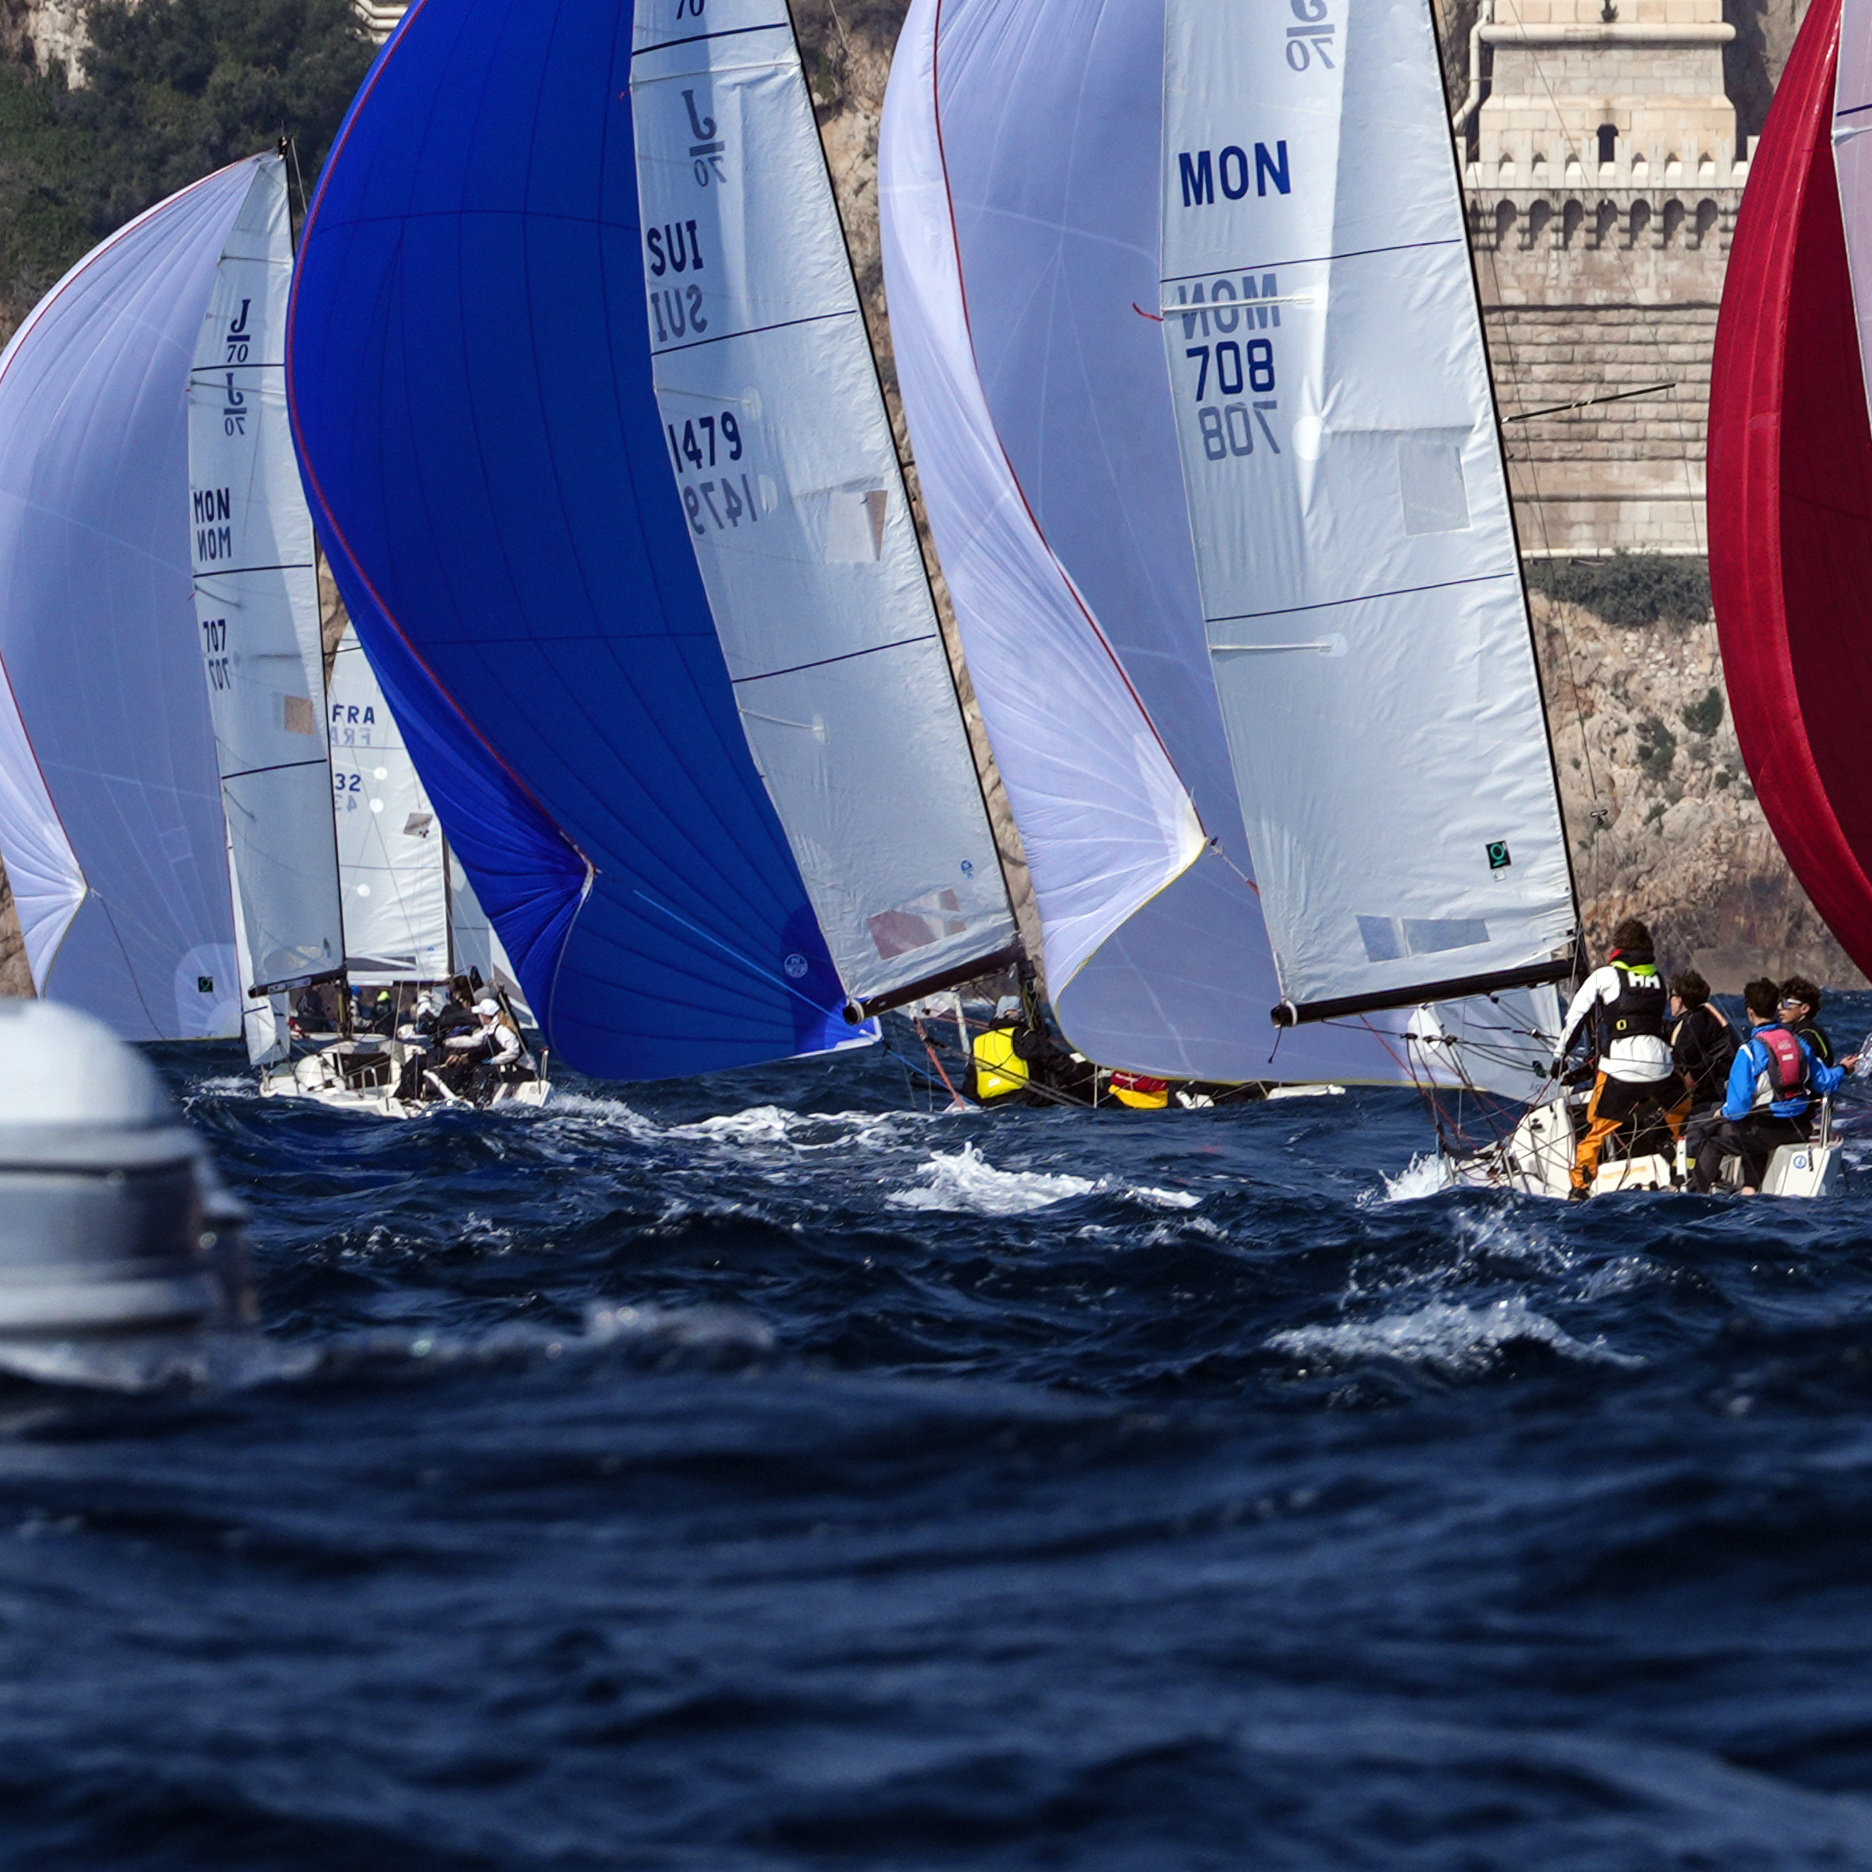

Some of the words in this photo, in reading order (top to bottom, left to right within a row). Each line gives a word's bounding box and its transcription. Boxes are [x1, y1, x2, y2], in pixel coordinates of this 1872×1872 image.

[1178, 140, 1292, 207] MON
[647, 220, 704, 277] SUI
[229, 298, 251, 334] J
[227, 342, 249, 364] 70
[1186, 338, 1276, 402] 708
[667, 411, 743, 474] 1479
[194, 487, 230, 524] MON
[203, 619, 227, 653] 707
[331, 704, 375, 725] FRA
